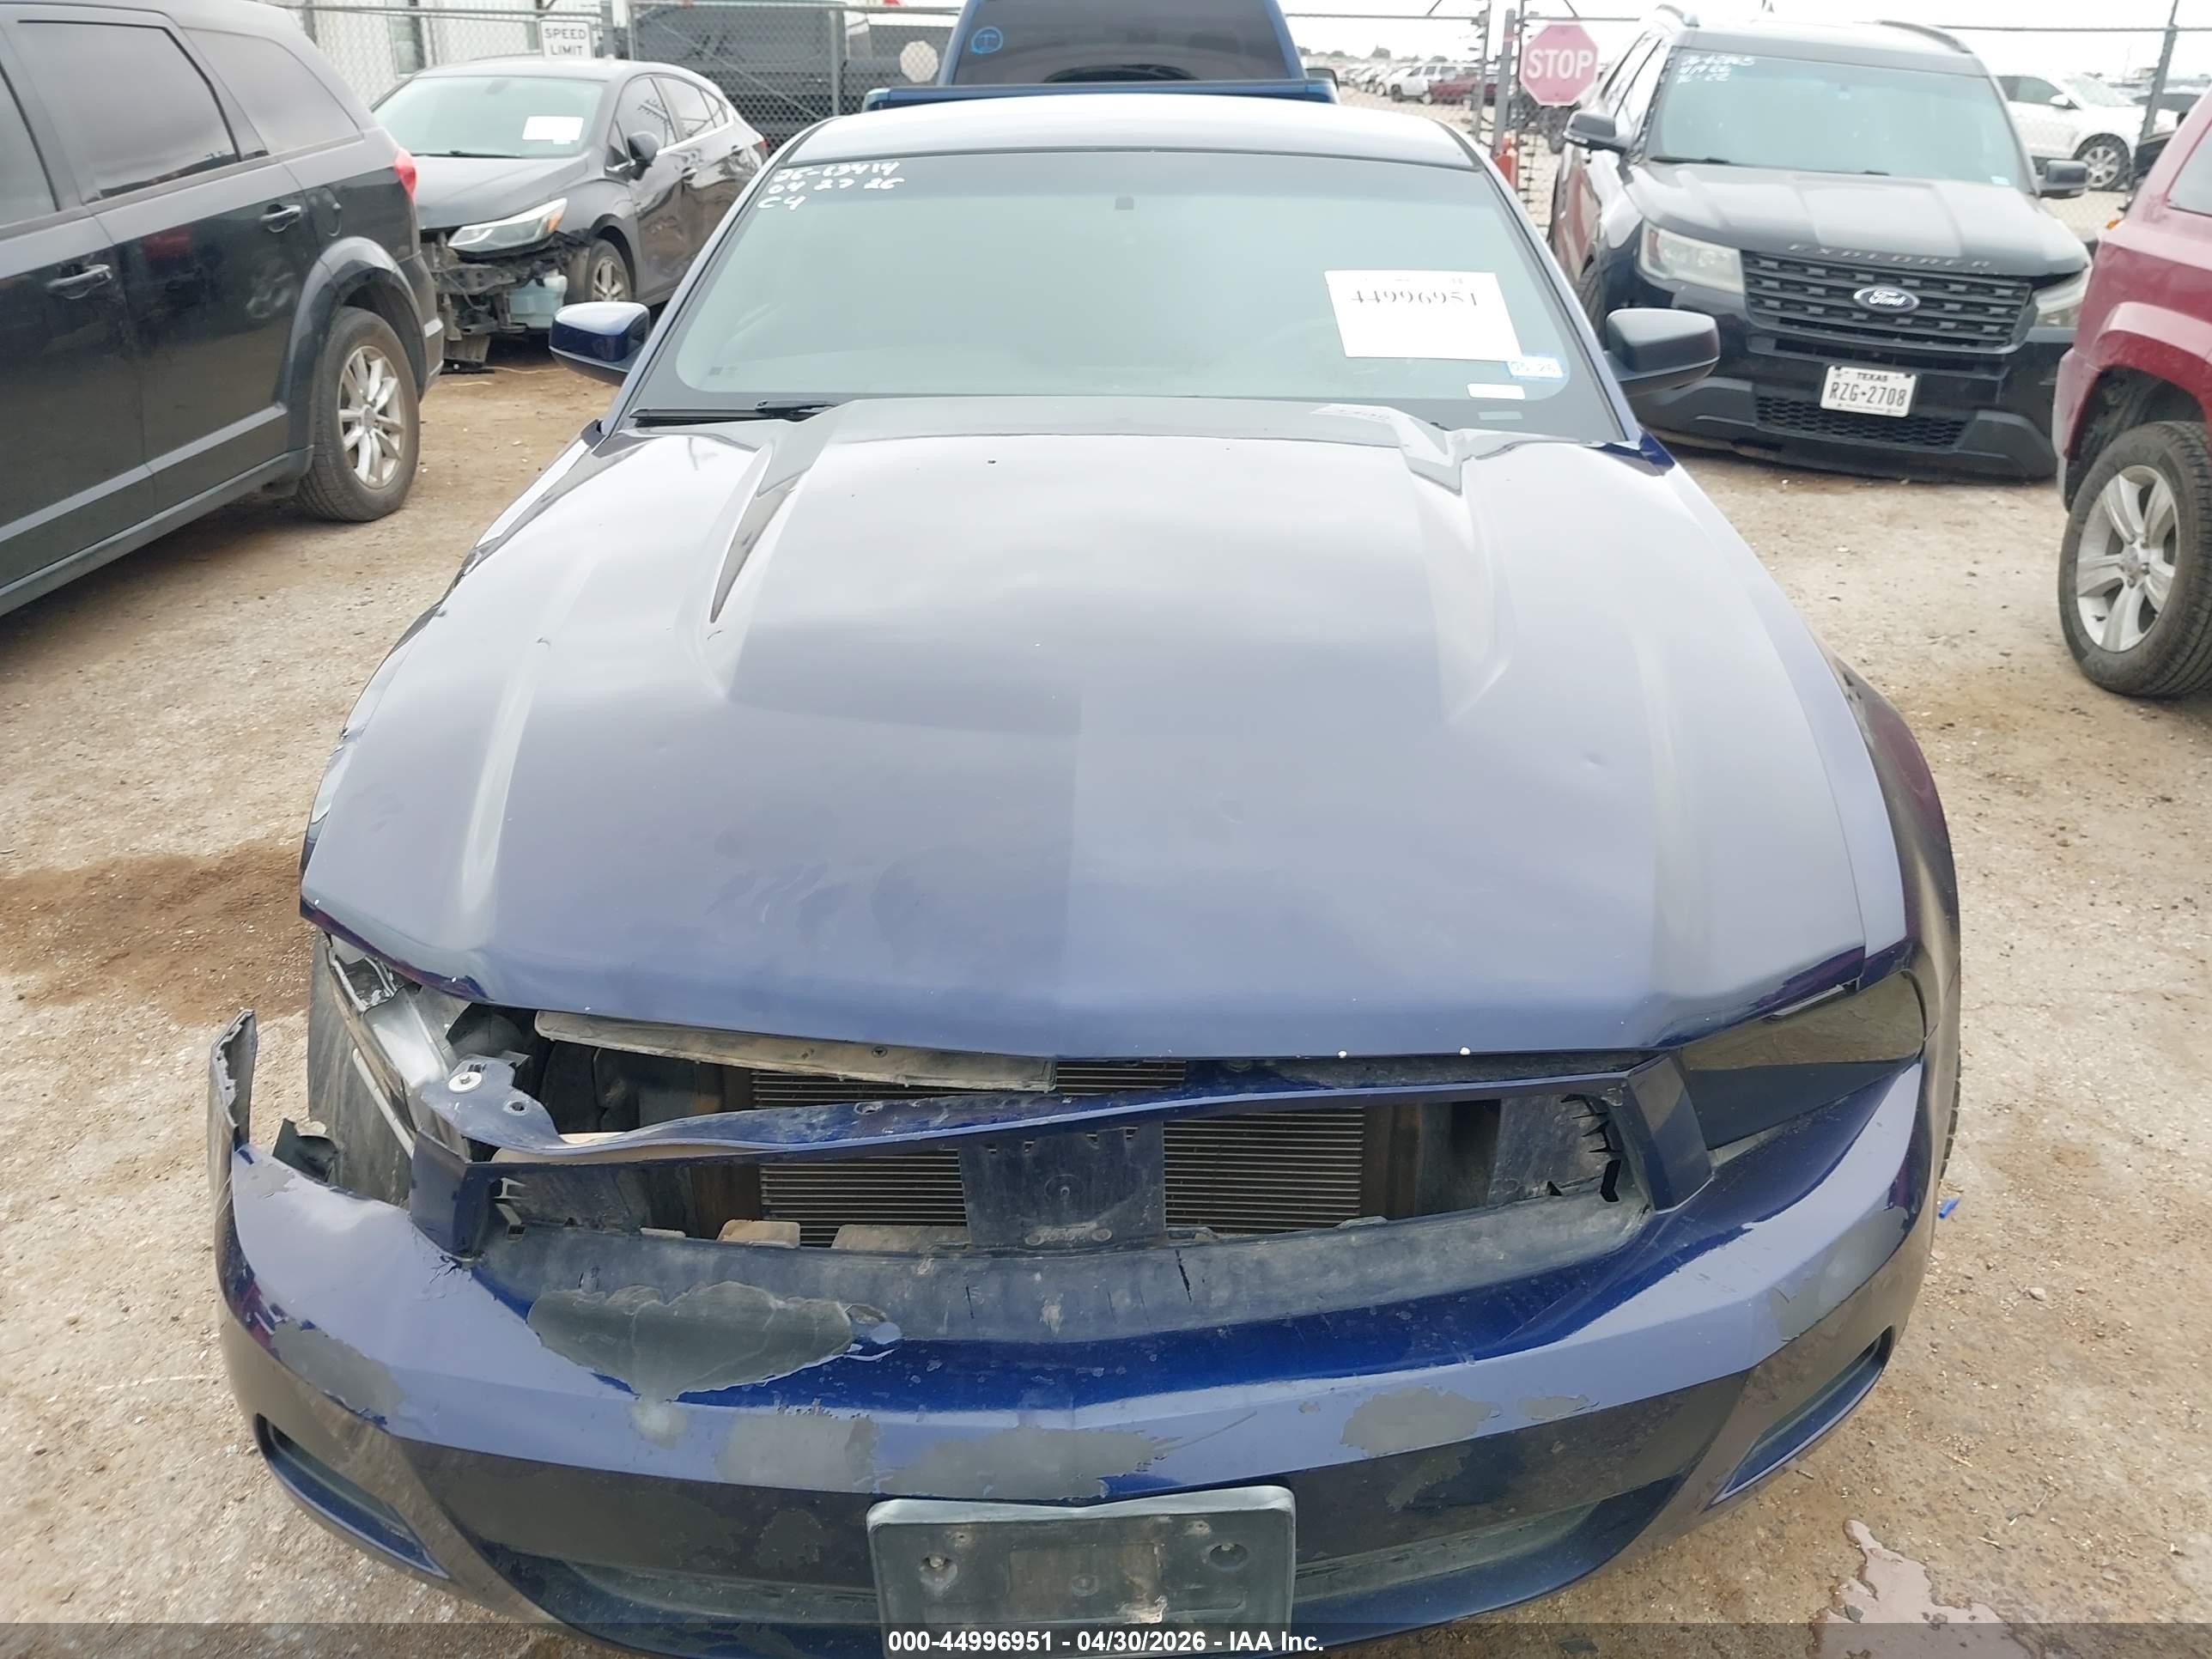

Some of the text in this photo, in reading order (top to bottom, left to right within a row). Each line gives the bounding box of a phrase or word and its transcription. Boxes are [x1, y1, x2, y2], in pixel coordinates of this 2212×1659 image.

[544, 27, 586, 40] SPEED
[550, 45, 583, 56] LIMIT
[1526, 49, 1594, 79] STOP
[1868, 289, 1907, 307] Ford
[1857, 372, 1887, 382] TEXAS
